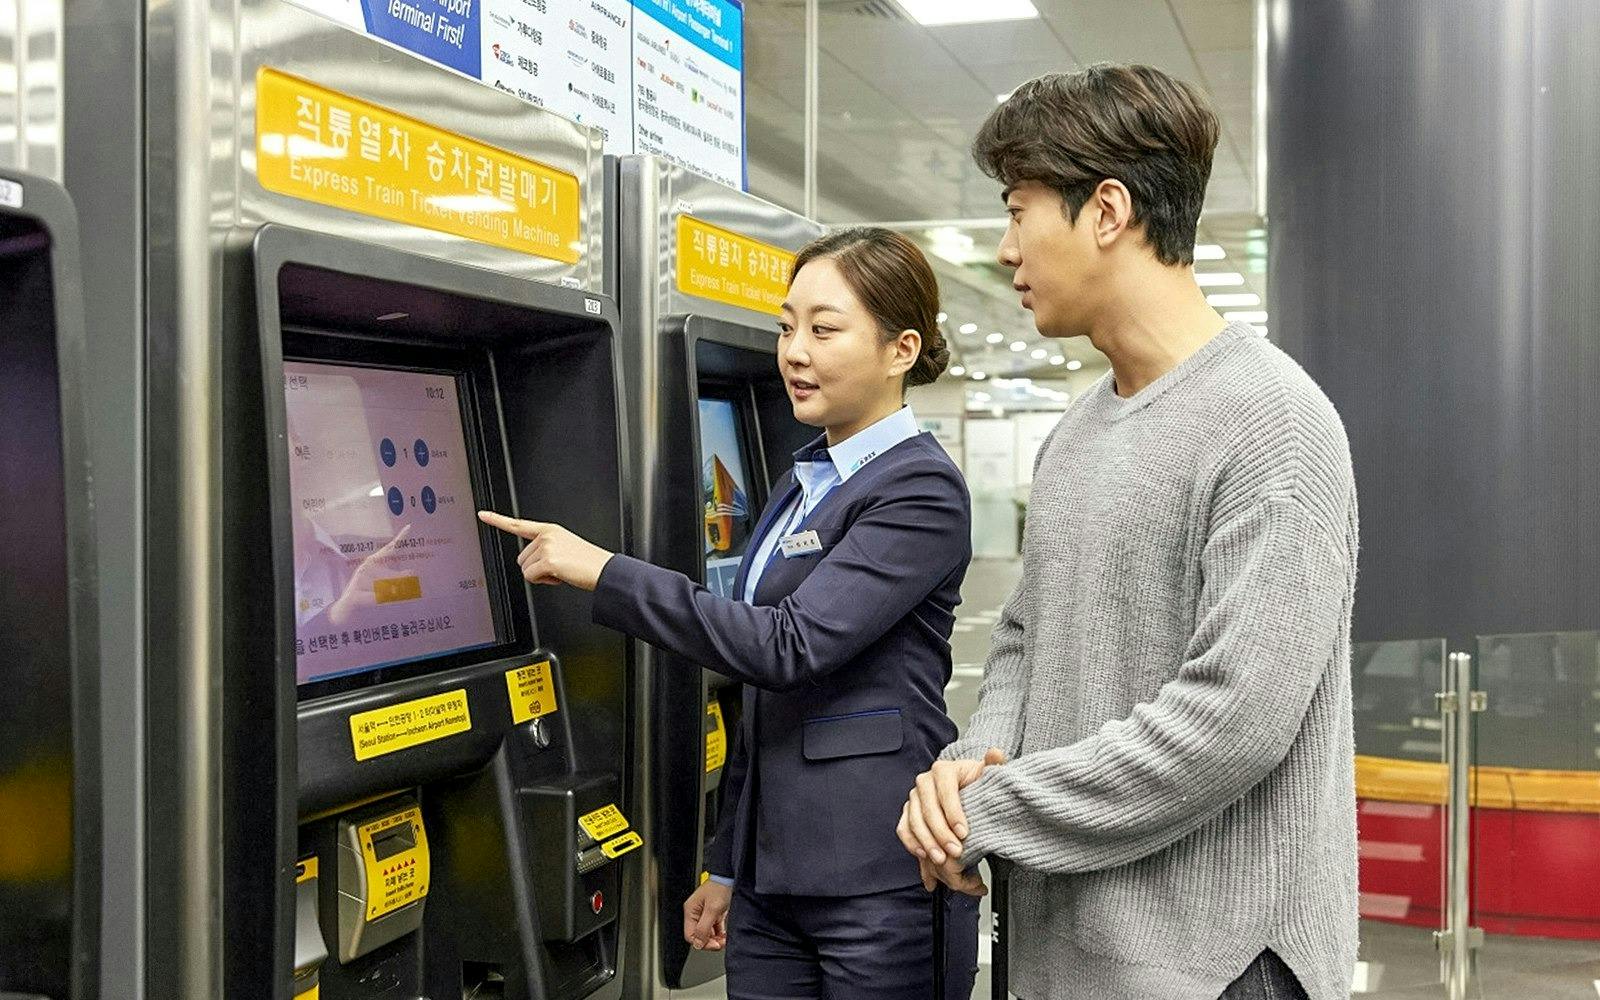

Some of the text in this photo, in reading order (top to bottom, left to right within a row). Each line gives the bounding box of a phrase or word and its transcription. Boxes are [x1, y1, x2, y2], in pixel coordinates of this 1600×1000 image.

[387, 0, 435, 34] Terminal
[436, 15, 466, 50] First!
[295, 94, 560, 216] 직통열차 승차권발매기
[290, 157, 359, 196] Express
[365, 175, 405, 208] Train
[512, 214, 562, 248] Machine
[692, 228, 743, 272] 직통열차
[690, 268, 720, 291] Express
[721, 276, 740, 297] Train
[309, 633, 338, 654] 선택한
[353, 623, 400, 645] 확인버튼을
